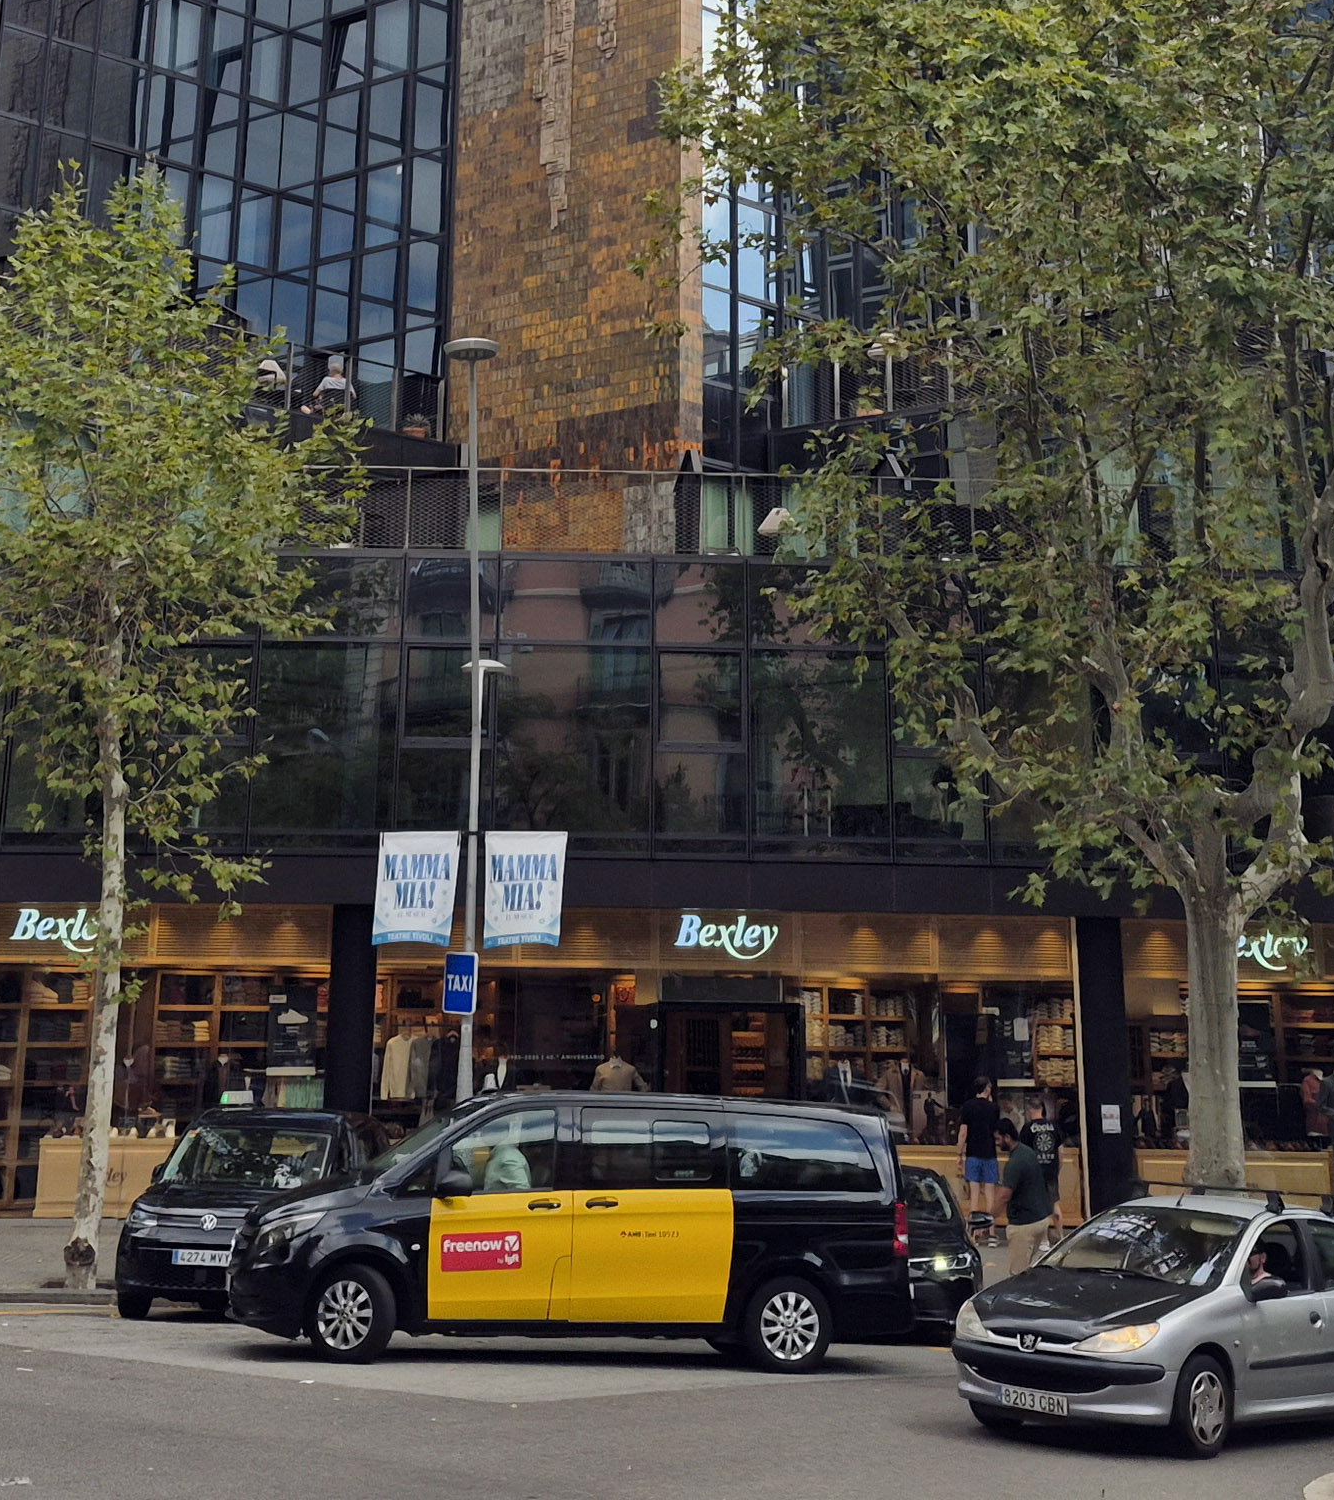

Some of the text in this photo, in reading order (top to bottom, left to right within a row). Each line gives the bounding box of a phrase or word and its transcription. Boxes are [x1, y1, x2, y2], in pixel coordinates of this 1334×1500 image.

[383, 853, 450, 881] MAMMA
[490, 854, 557, 883] MAMMA
[394, 881, 435, 909] MIA!
[501, 882, 543, 912] MIA!
[9, 908, 99, 953] Bexle
[674, 915, 779, 960] Bexley
[1237, 929, 1309, 971] exley
[447, 974, 473, 993] TAXI
[180, 1252, 206, 1263] 4274
[1005, 1388, 1065, 1415] 8203 CBN
